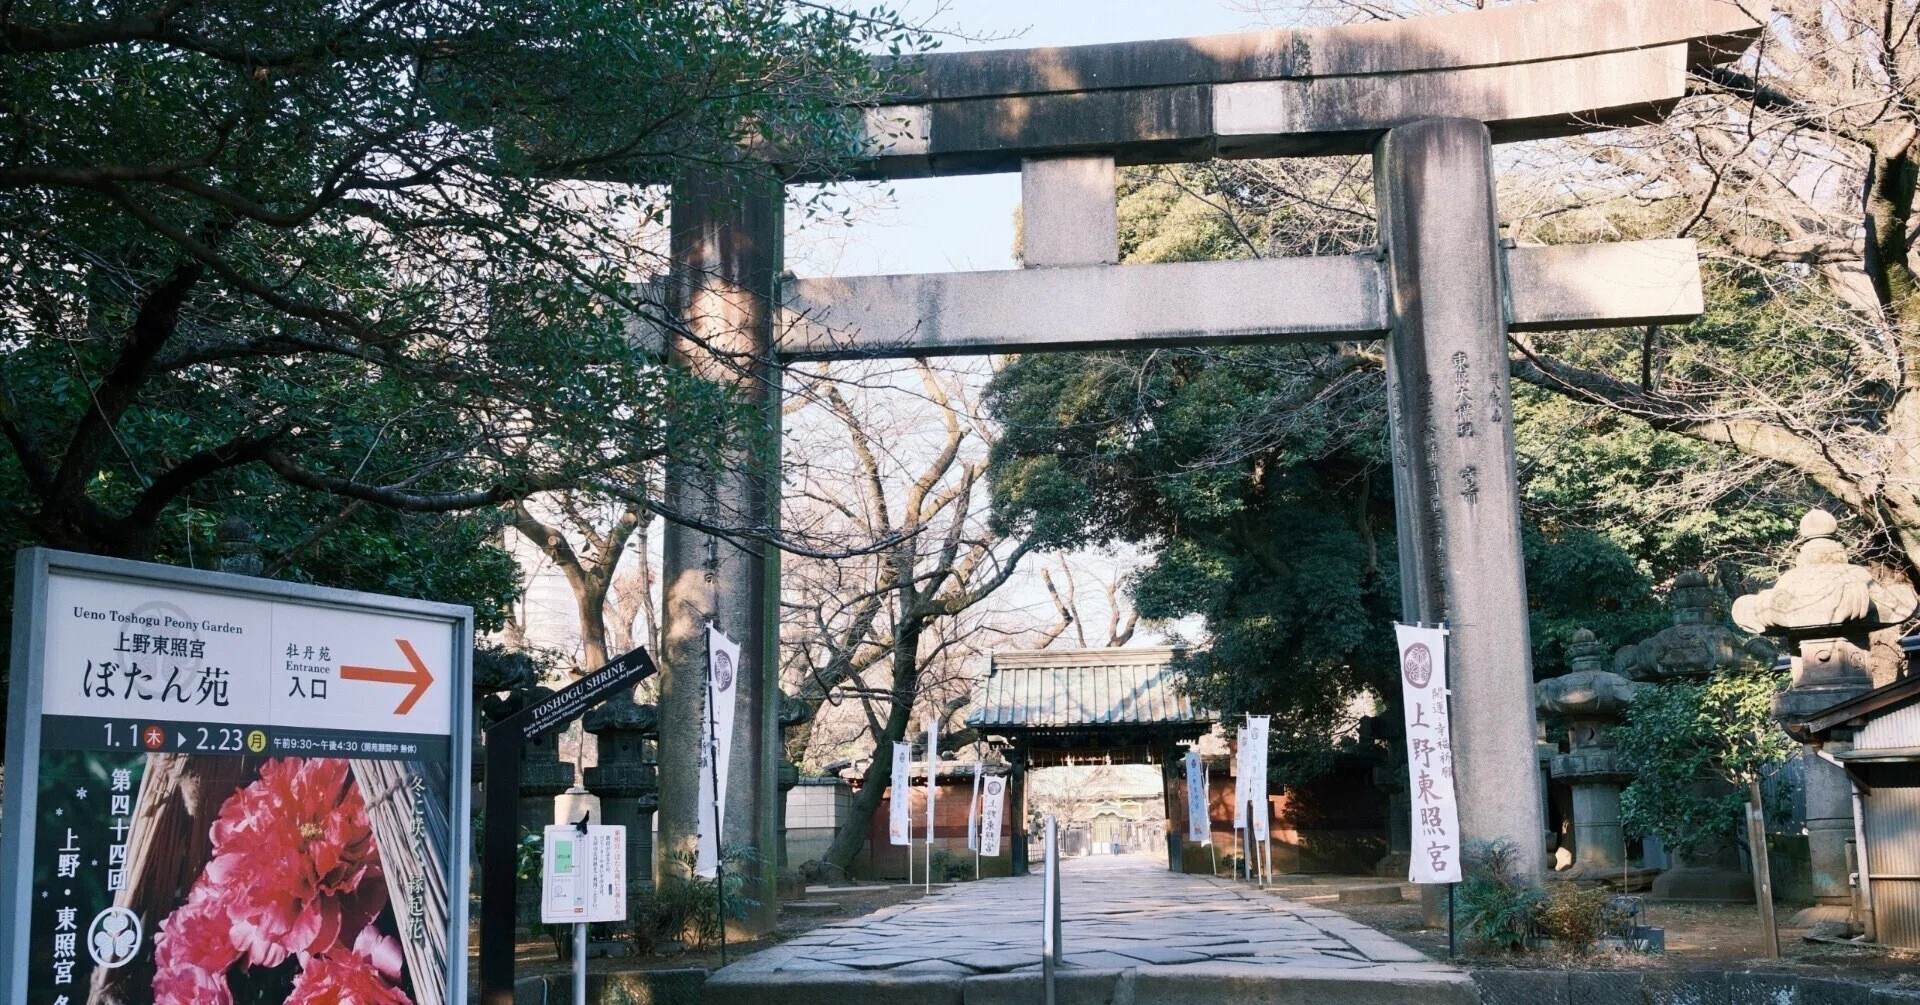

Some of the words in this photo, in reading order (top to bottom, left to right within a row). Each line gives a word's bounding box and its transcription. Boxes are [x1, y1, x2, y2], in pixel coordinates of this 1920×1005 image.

[73, 606, 106, 620] Ueno
[109, 610, 160, 627] Toshogu
[164, 616, 199, 631] Peony
[201, 620, 243, 634] Garden
[113, 631, 206, 659] 上野東照宮
[286, 643, 331, 661] 牡丹苑
[286, 660, 330, 674] Entrance
[83, 659, 230, 707] ぼたん苑
[289, 676, 327, 700] 入口
[532, 685, 585, 719] TOSHOGU
[586, 661, 626, 690] SHRINE
[146, 729, 162, 745] 木
[196, 727, 243, 751] 2.23
[250, 734, 262, 748] 月
[1410, 702, 1451, 873] 上野東照宮
[108, 768, 132, 892] 第四十四回
[407, 775, 426, 940] 冬に咲く、縁起花
